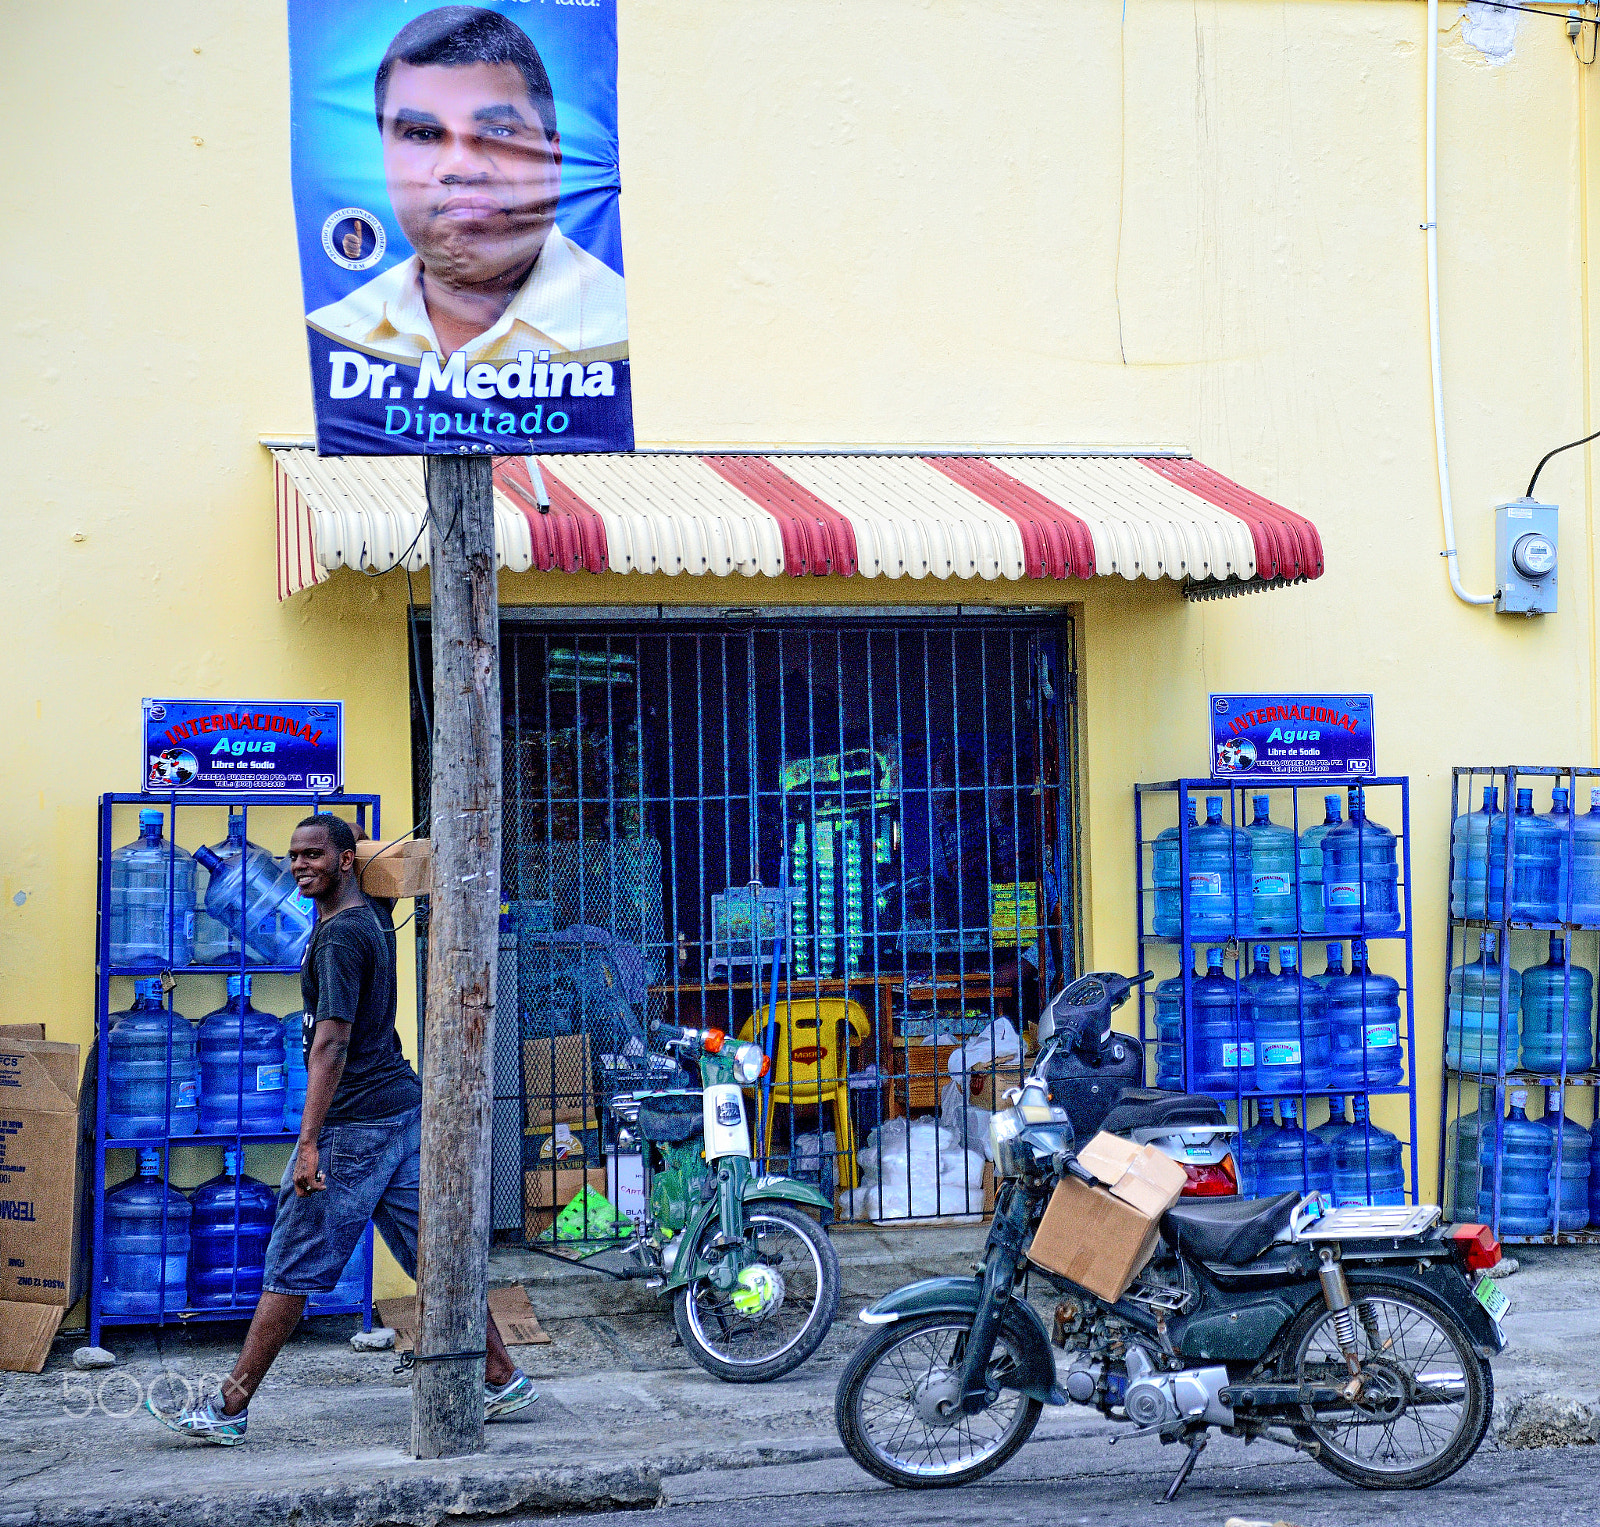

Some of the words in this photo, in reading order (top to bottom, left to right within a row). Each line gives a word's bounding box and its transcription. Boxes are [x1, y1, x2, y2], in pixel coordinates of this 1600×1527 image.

[328, 350, 402, 399] Dr.
[413, 349, 616, 399] Medina
[384, 404, 570, 443] Diputado
[164, 713, 324, 747] INTERNACIONAL
[1228, 705, 1360, 735] INTERNACIONAL
[210, 737, 277, 756] Agua
[1266, 727, 1321, 744] Agua
[1267, 748, 1287, 756] Libre
[1288, 748, 1298, 756] de
[1299, 748, 1321, 756] Sodio
[211, 760, 235, 769] Libre
[237, 760, 248, 769] de
[249, 760, 275, 769] Sodio
